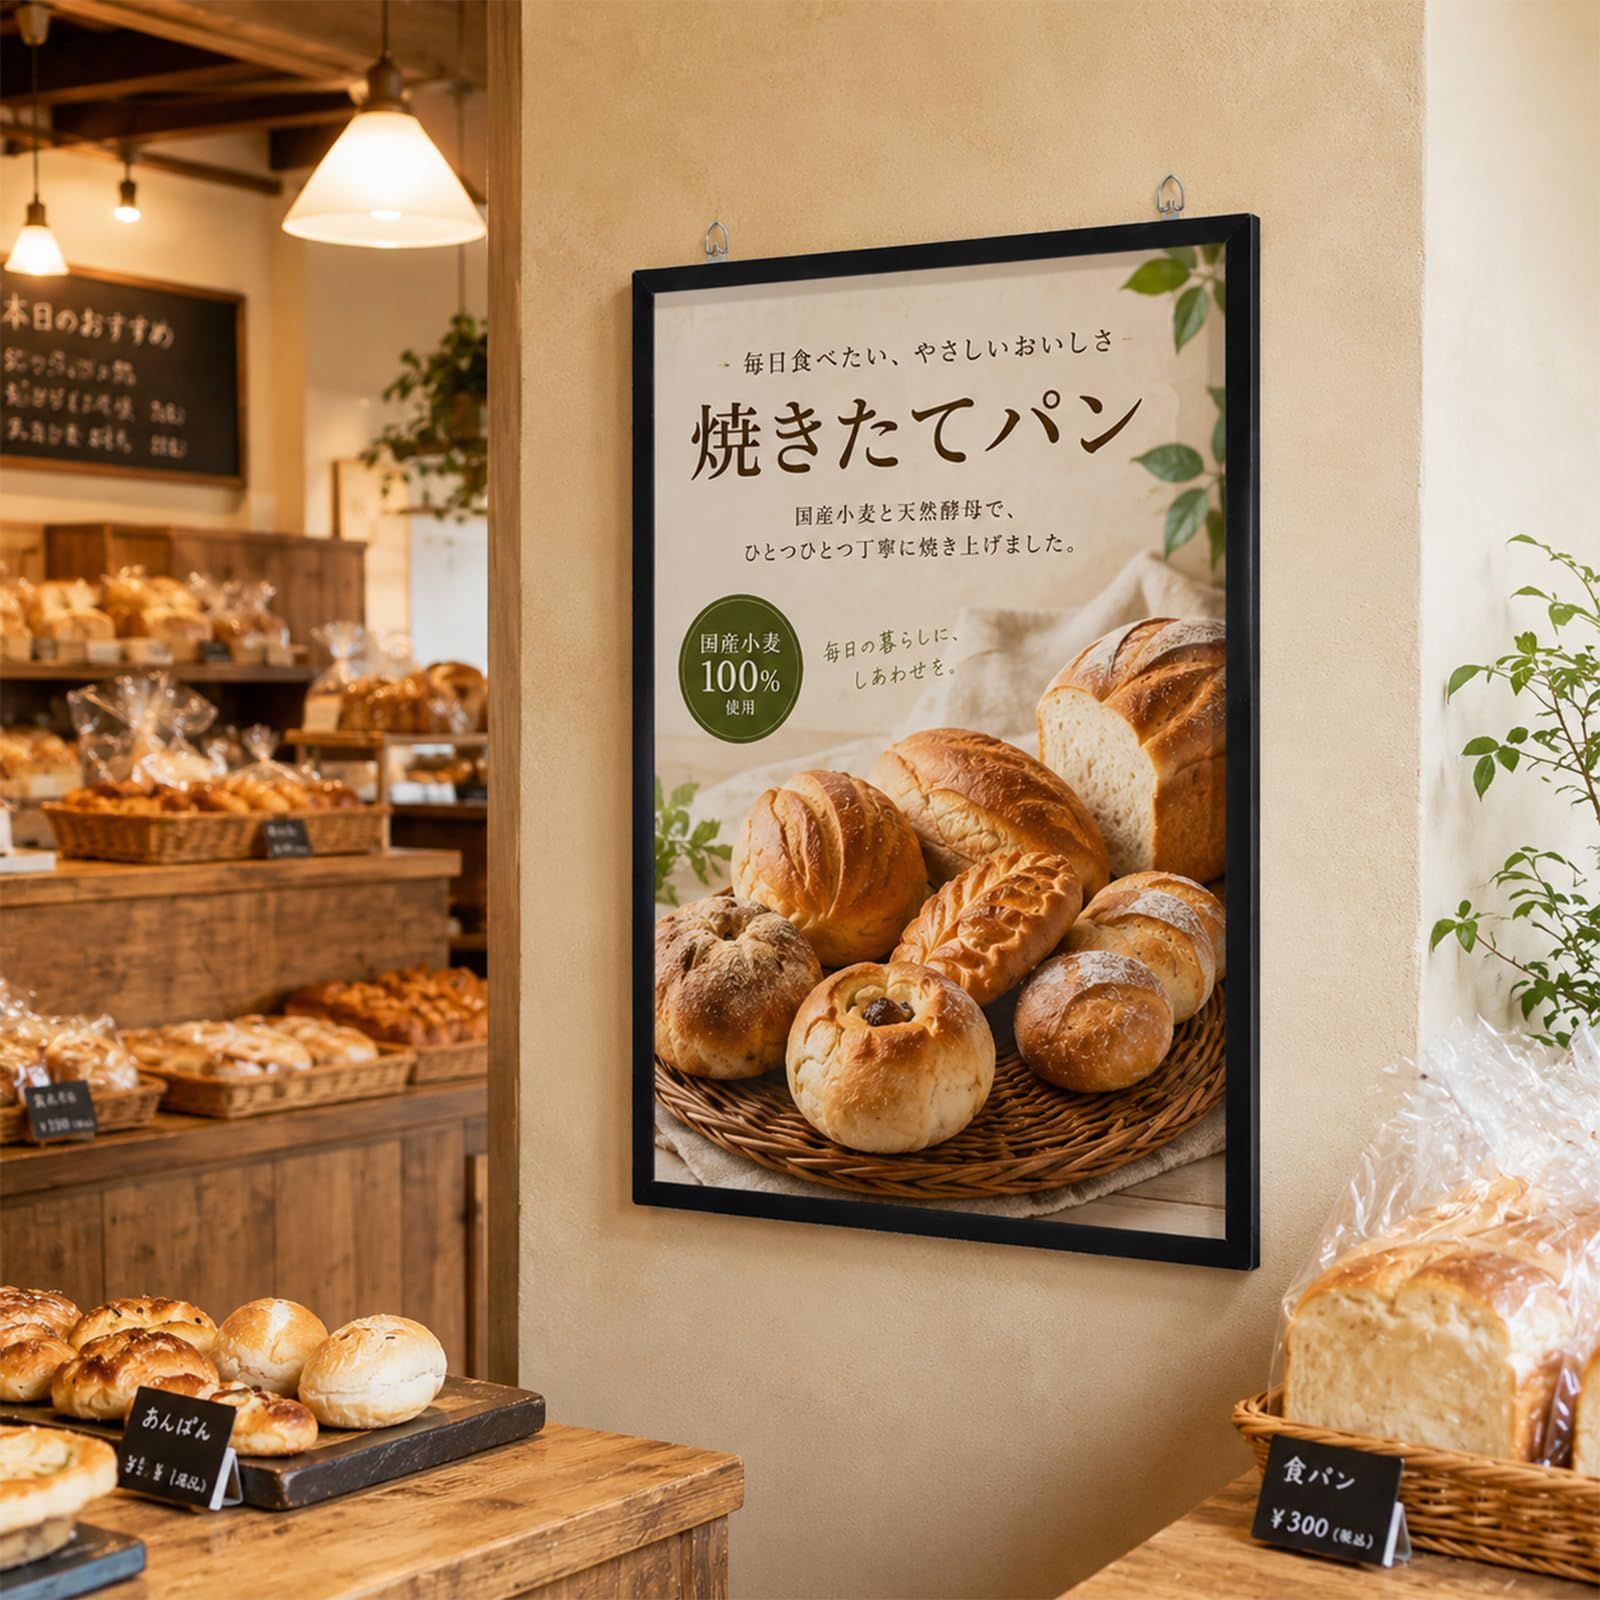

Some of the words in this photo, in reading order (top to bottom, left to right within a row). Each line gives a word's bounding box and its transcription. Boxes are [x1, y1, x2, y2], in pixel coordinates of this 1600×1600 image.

[2, 292, 175, 349] 本日のおすすめ
[743, 329, 1113, 376] 毎日食べたい、やさしいおいしさ
[690, 389, 1143, 481] 焼きたてパン
[794, 499, 1016, 527] 国産小麦と天然酵母で、
[744, 533, 1076, 562] ひとつひとつ丁寧に焼き上げました。
[700, 632, 781, 654] 国産小麦
[823, 628, 958, 664] 毎日の暮らしに、
[701, 659, 781, 693] 100%
[855, 657, 956, 690] しあわせを。
[726, 699, 755, 716] 使用
[142, 1406, 210, 1441] あんぱん
[1283, 1456, 1356, 1490] 食パン
